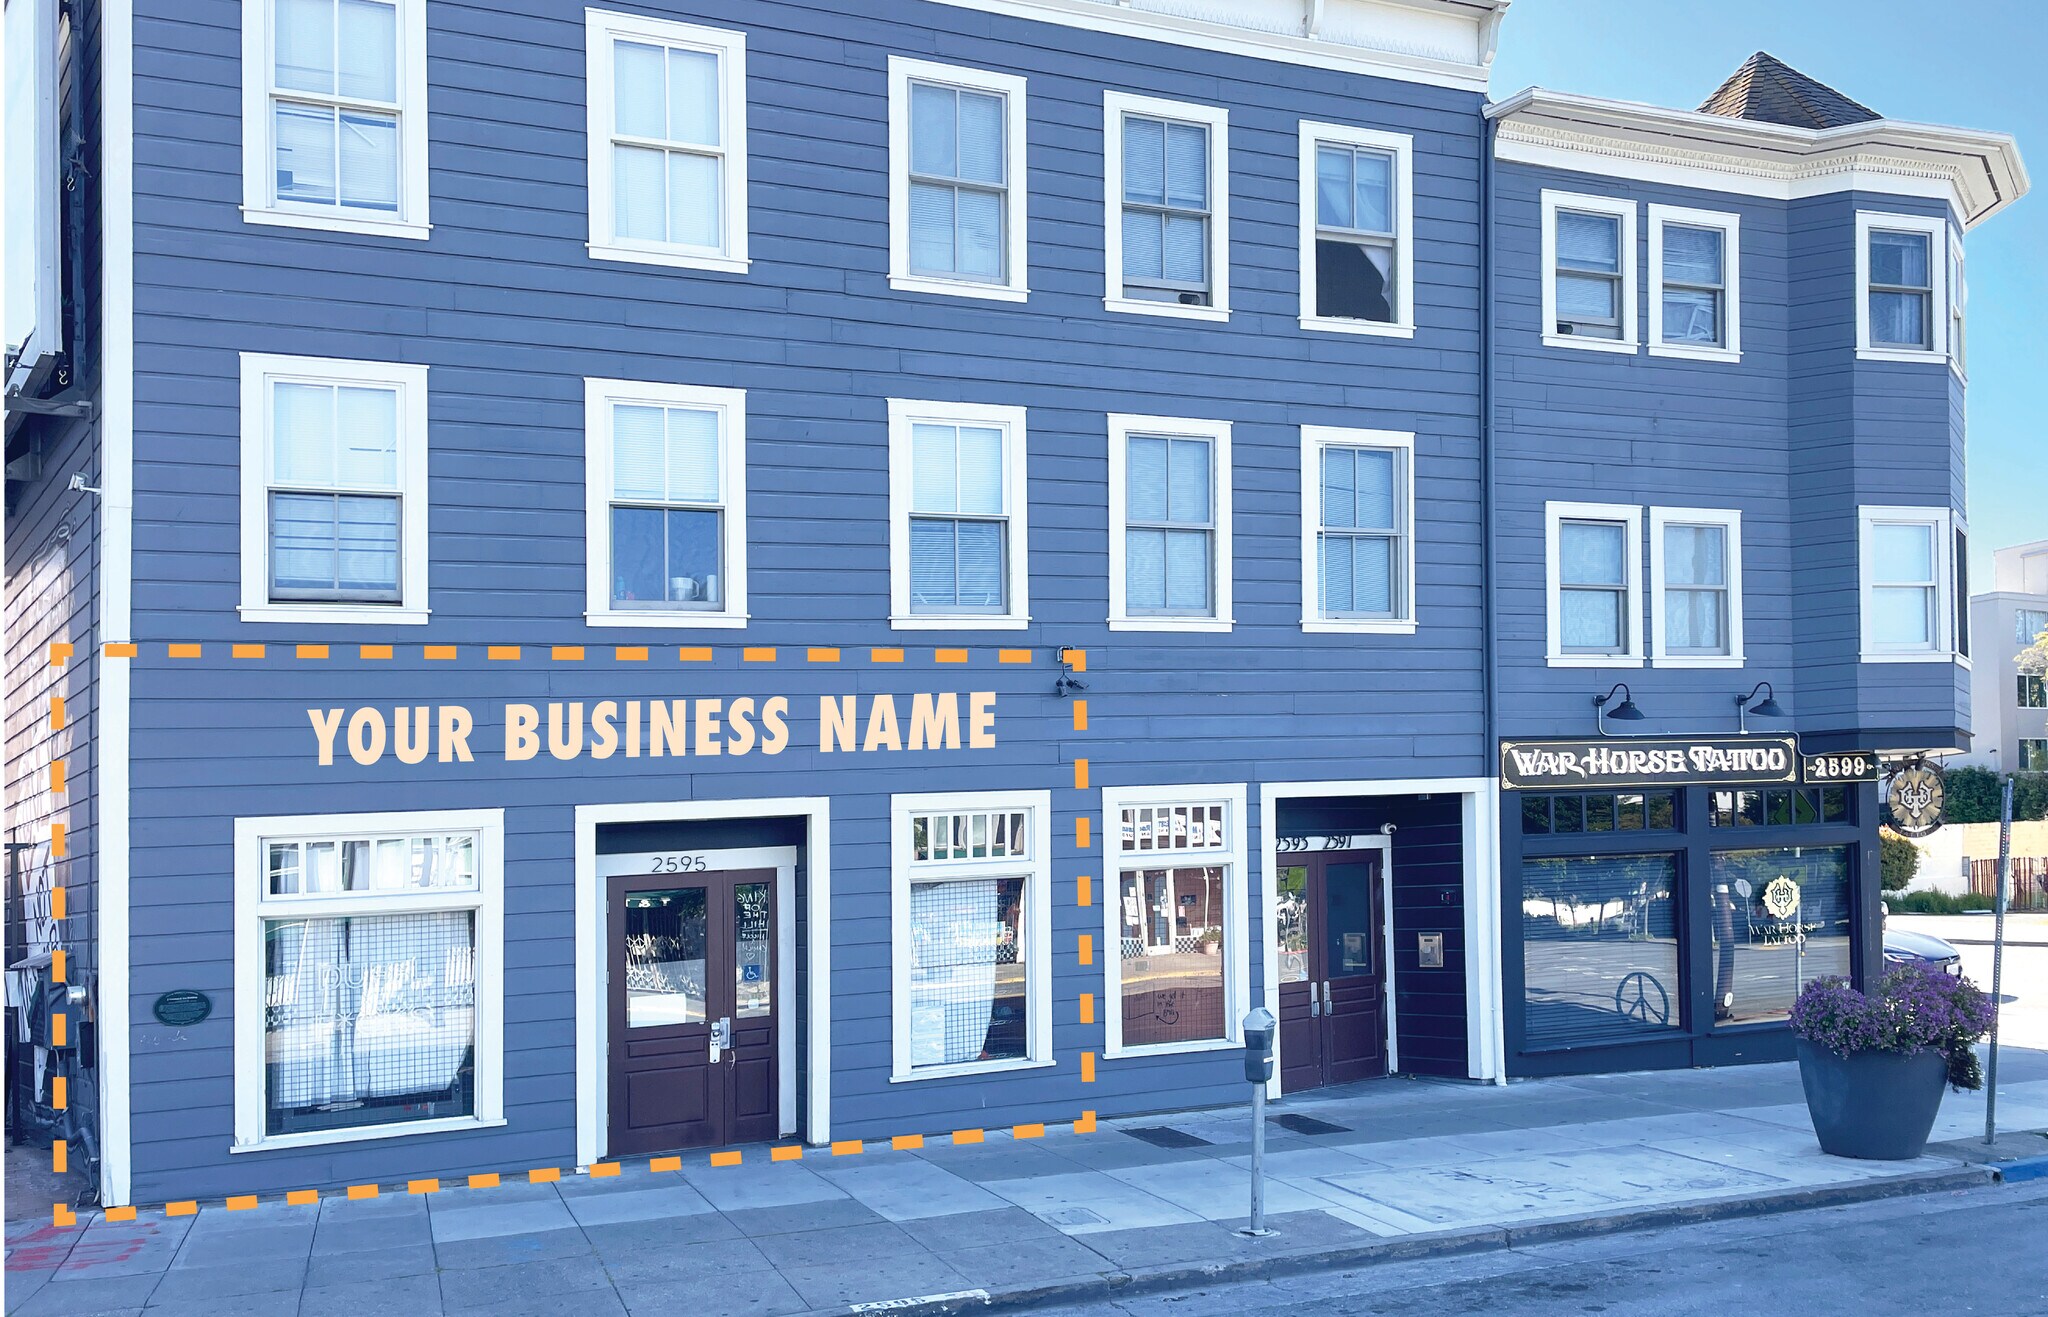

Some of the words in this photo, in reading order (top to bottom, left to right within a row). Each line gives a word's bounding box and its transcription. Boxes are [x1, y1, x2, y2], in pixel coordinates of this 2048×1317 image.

[1510, 748, 1587, 779] WAR
[1581, 747, 1690, 775] HORSE
[1689, 746, 1786, 772] TATTOO
[1815, 757, 1866, 778] 2599
[651, 855, 706, 872] 2595
